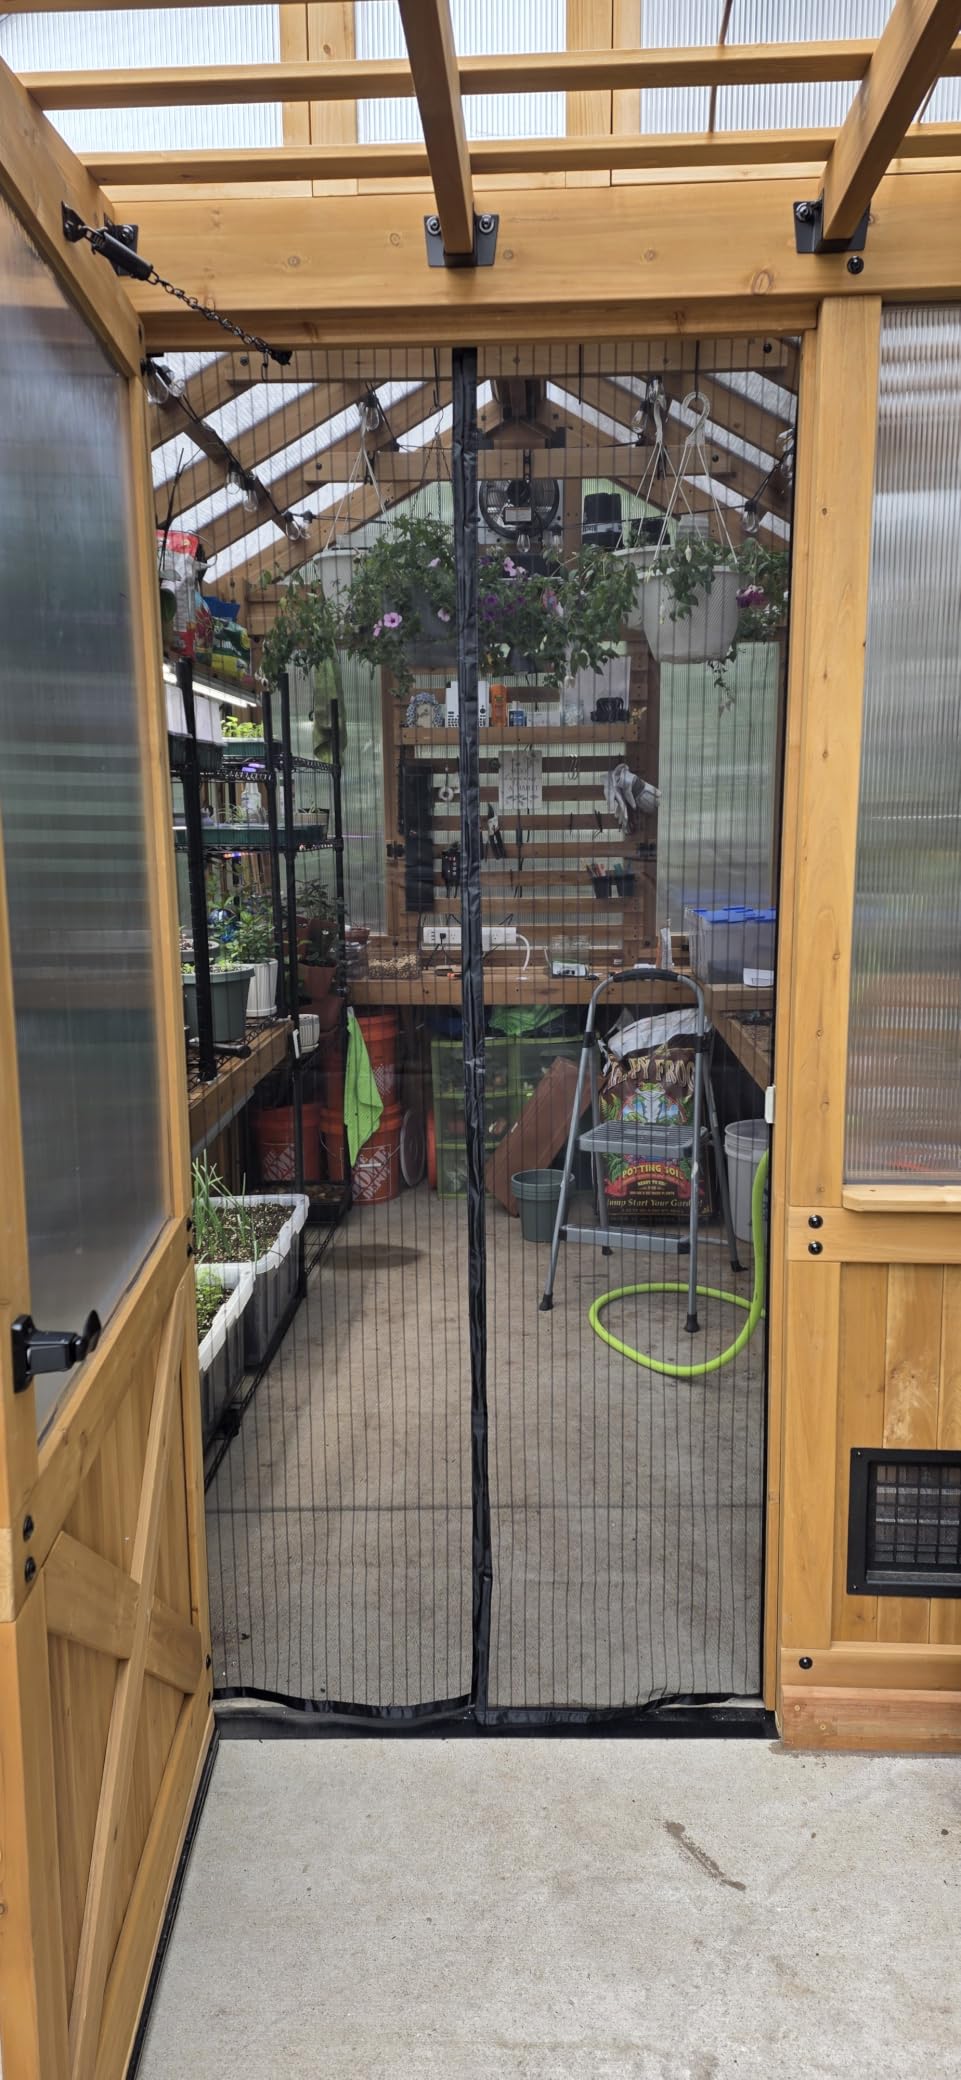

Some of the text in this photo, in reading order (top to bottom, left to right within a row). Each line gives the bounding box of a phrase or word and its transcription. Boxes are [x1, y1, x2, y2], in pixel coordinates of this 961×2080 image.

[622, 1164, 662, 1179] POTTING
[628, 1198, 649, 1207] Start
[650, 1199, 669, 1207] Your
